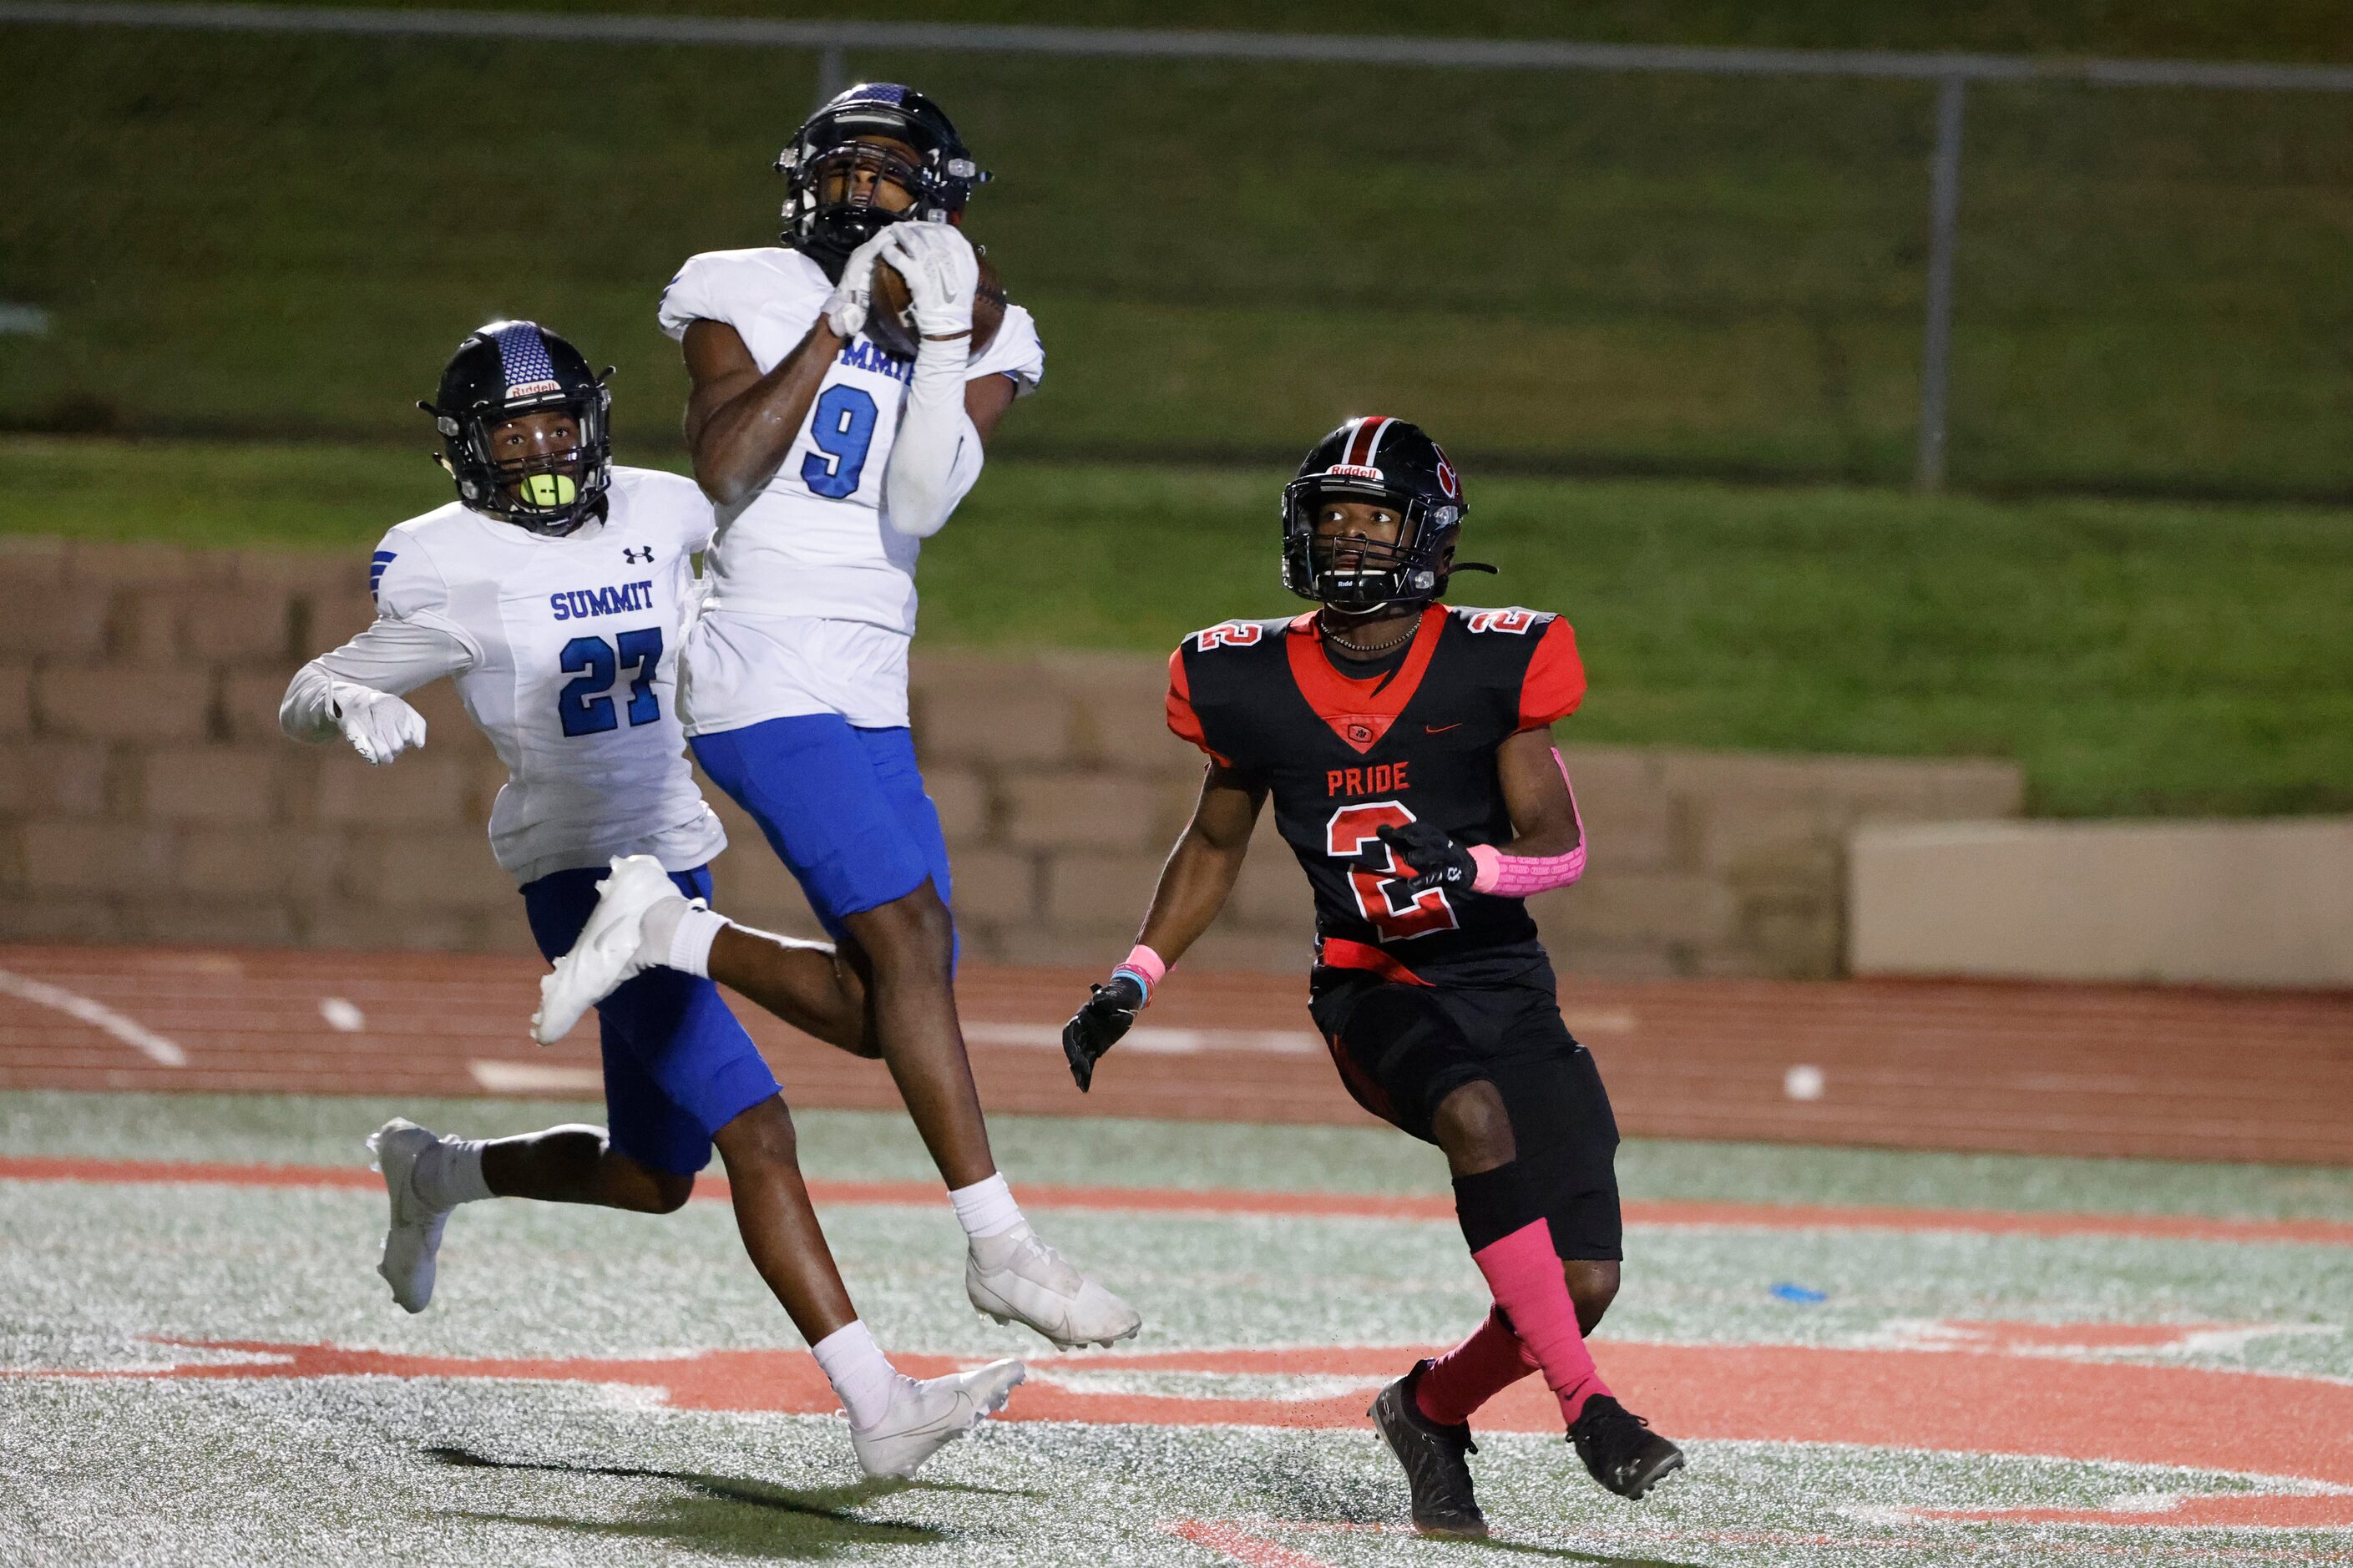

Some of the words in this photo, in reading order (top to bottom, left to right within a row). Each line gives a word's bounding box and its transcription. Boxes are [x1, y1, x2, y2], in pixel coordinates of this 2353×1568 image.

[512, 382, 555, 397] Riddell
[800, 383, 878, 499] 9
[1331, 466, 1377, 479] Riddell
[550, 580, 652, 621] SUMMIT
[1197, 624, 1263, 653] 2
[1467, 610, 1538, 635] 2
[558, 626, 663, 738] 27
[1327, 761, 1410, 797] PRIDE
[1326, 800, 1460, 943] 2
